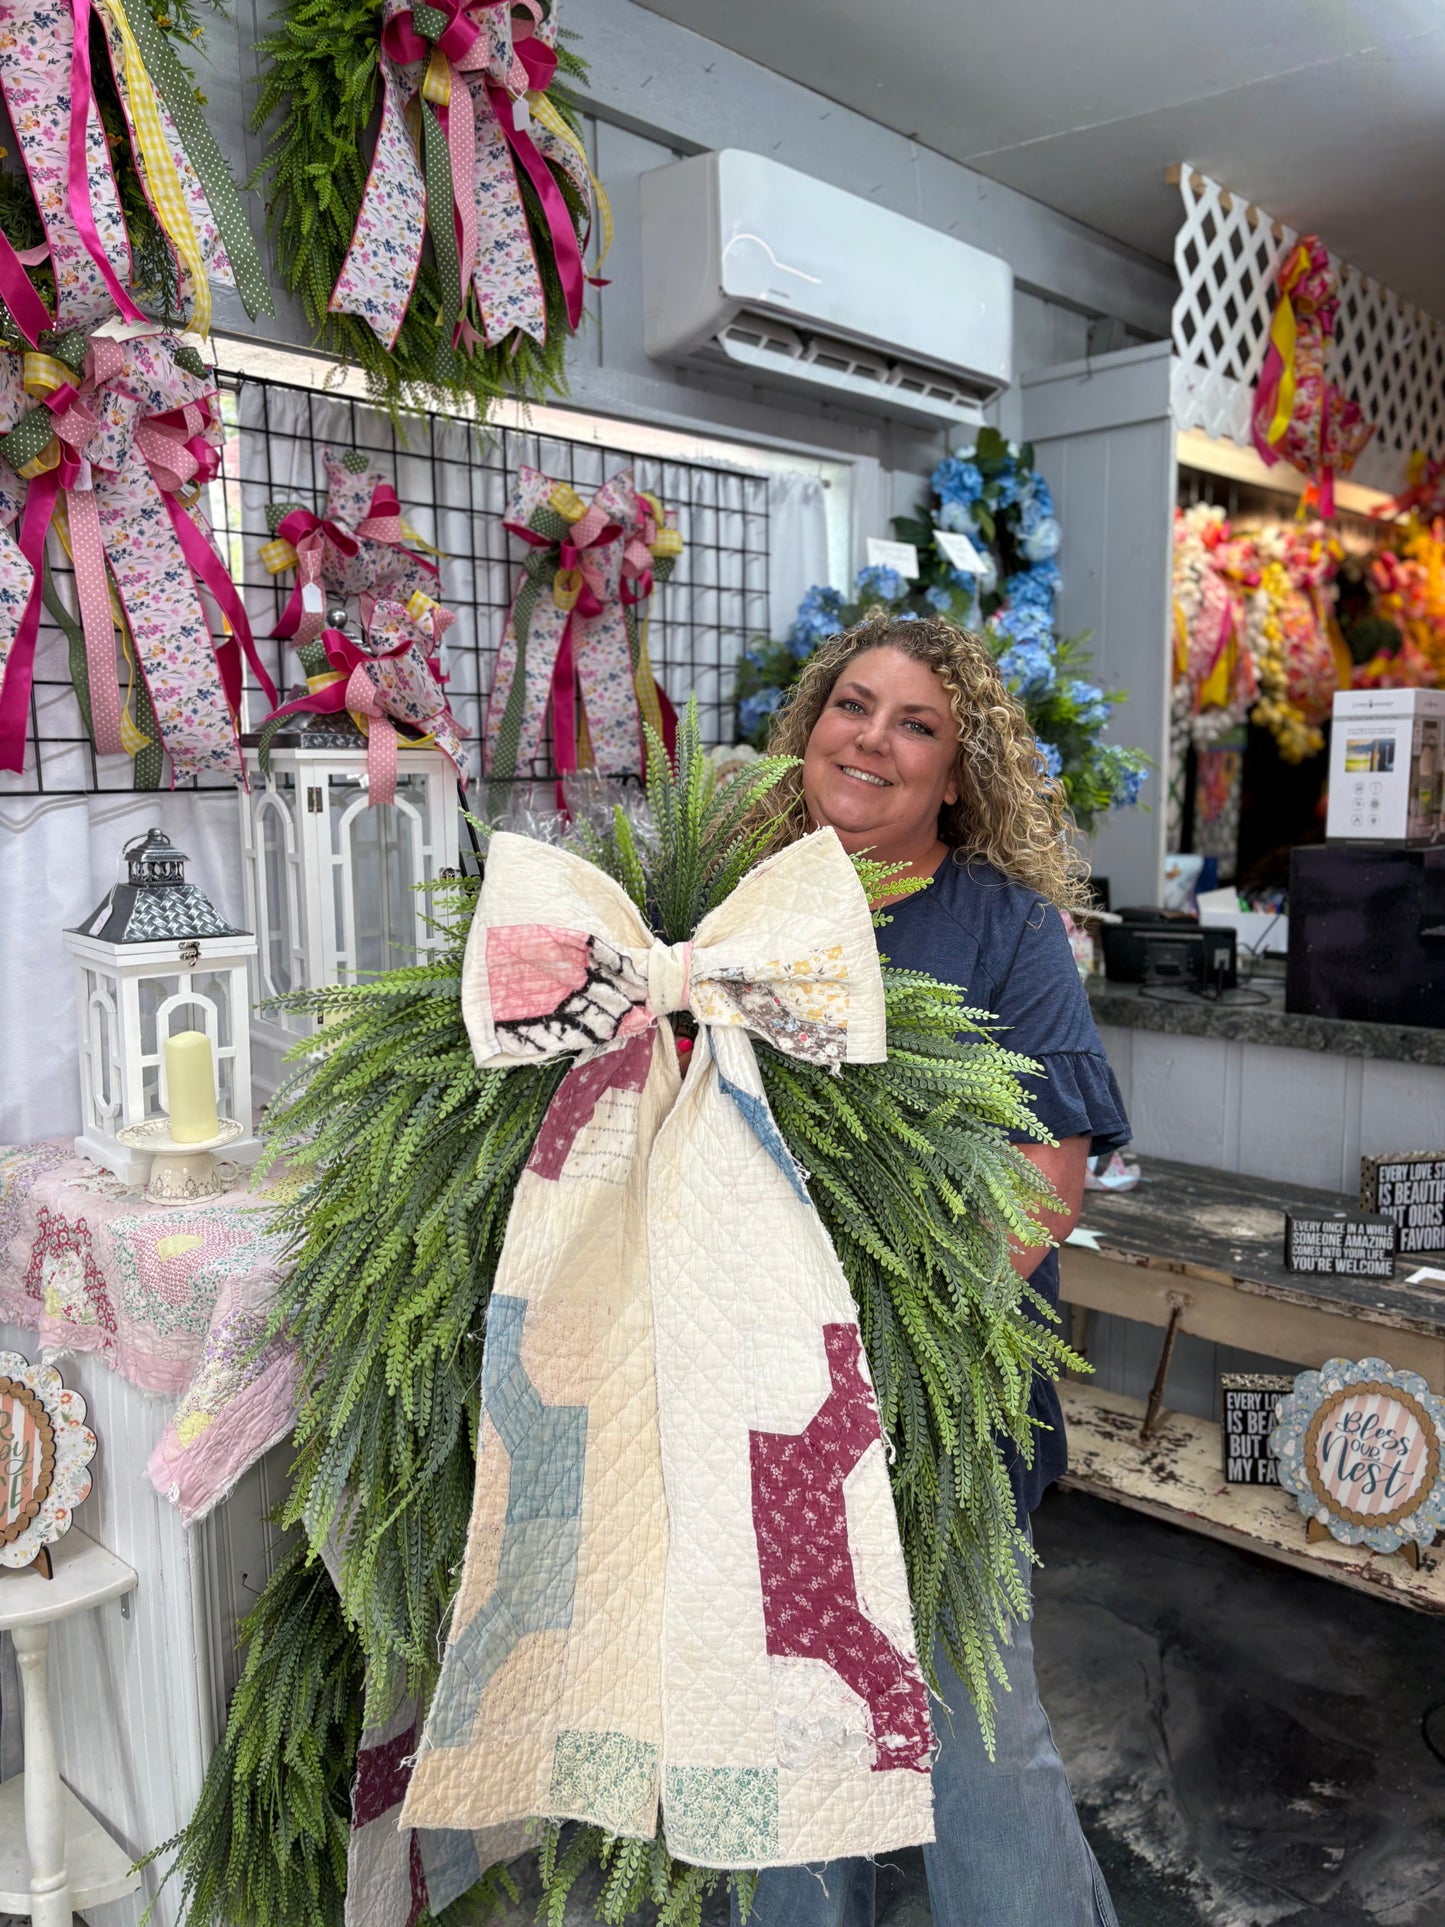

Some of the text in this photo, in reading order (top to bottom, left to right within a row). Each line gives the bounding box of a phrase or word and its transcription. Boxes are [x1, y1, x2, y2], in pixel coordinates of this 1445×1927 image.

[1379, 1164, 1408, 1182] EVERY
[1410, 1162, 1433, 1180] LOVE
[1378, 1183, 1392, 1206] IS
[1408, 1203, 1444, 1227] OURS
[1293, 1221, 1394, 1236] EVERY ONCE IN A WHILE
[1400, 1226, 1445, 1251] FAVORI
[1292, 1245, 1320, 1256] COMES
[1322, 1246, 1340, 1257] INTO
[1343, 1248, 1366, 1259] YOUR
[1293, 1232, 1394, 1249] SOMEONE AMAZING
[1292, 1256, 1392, 1275] YOU'RE WELCOME
[1227, 1392, 1262, 1410] EVERY
[1227, 1410, 1243, 1434] IS
[1335, 1411, 1409, 1455] Bless
[1230, 1434, 1262, 1458] BUT
[1351, 1438, 1380, 1461] OUR
[1228, 1458, 1253, 1482] MY
